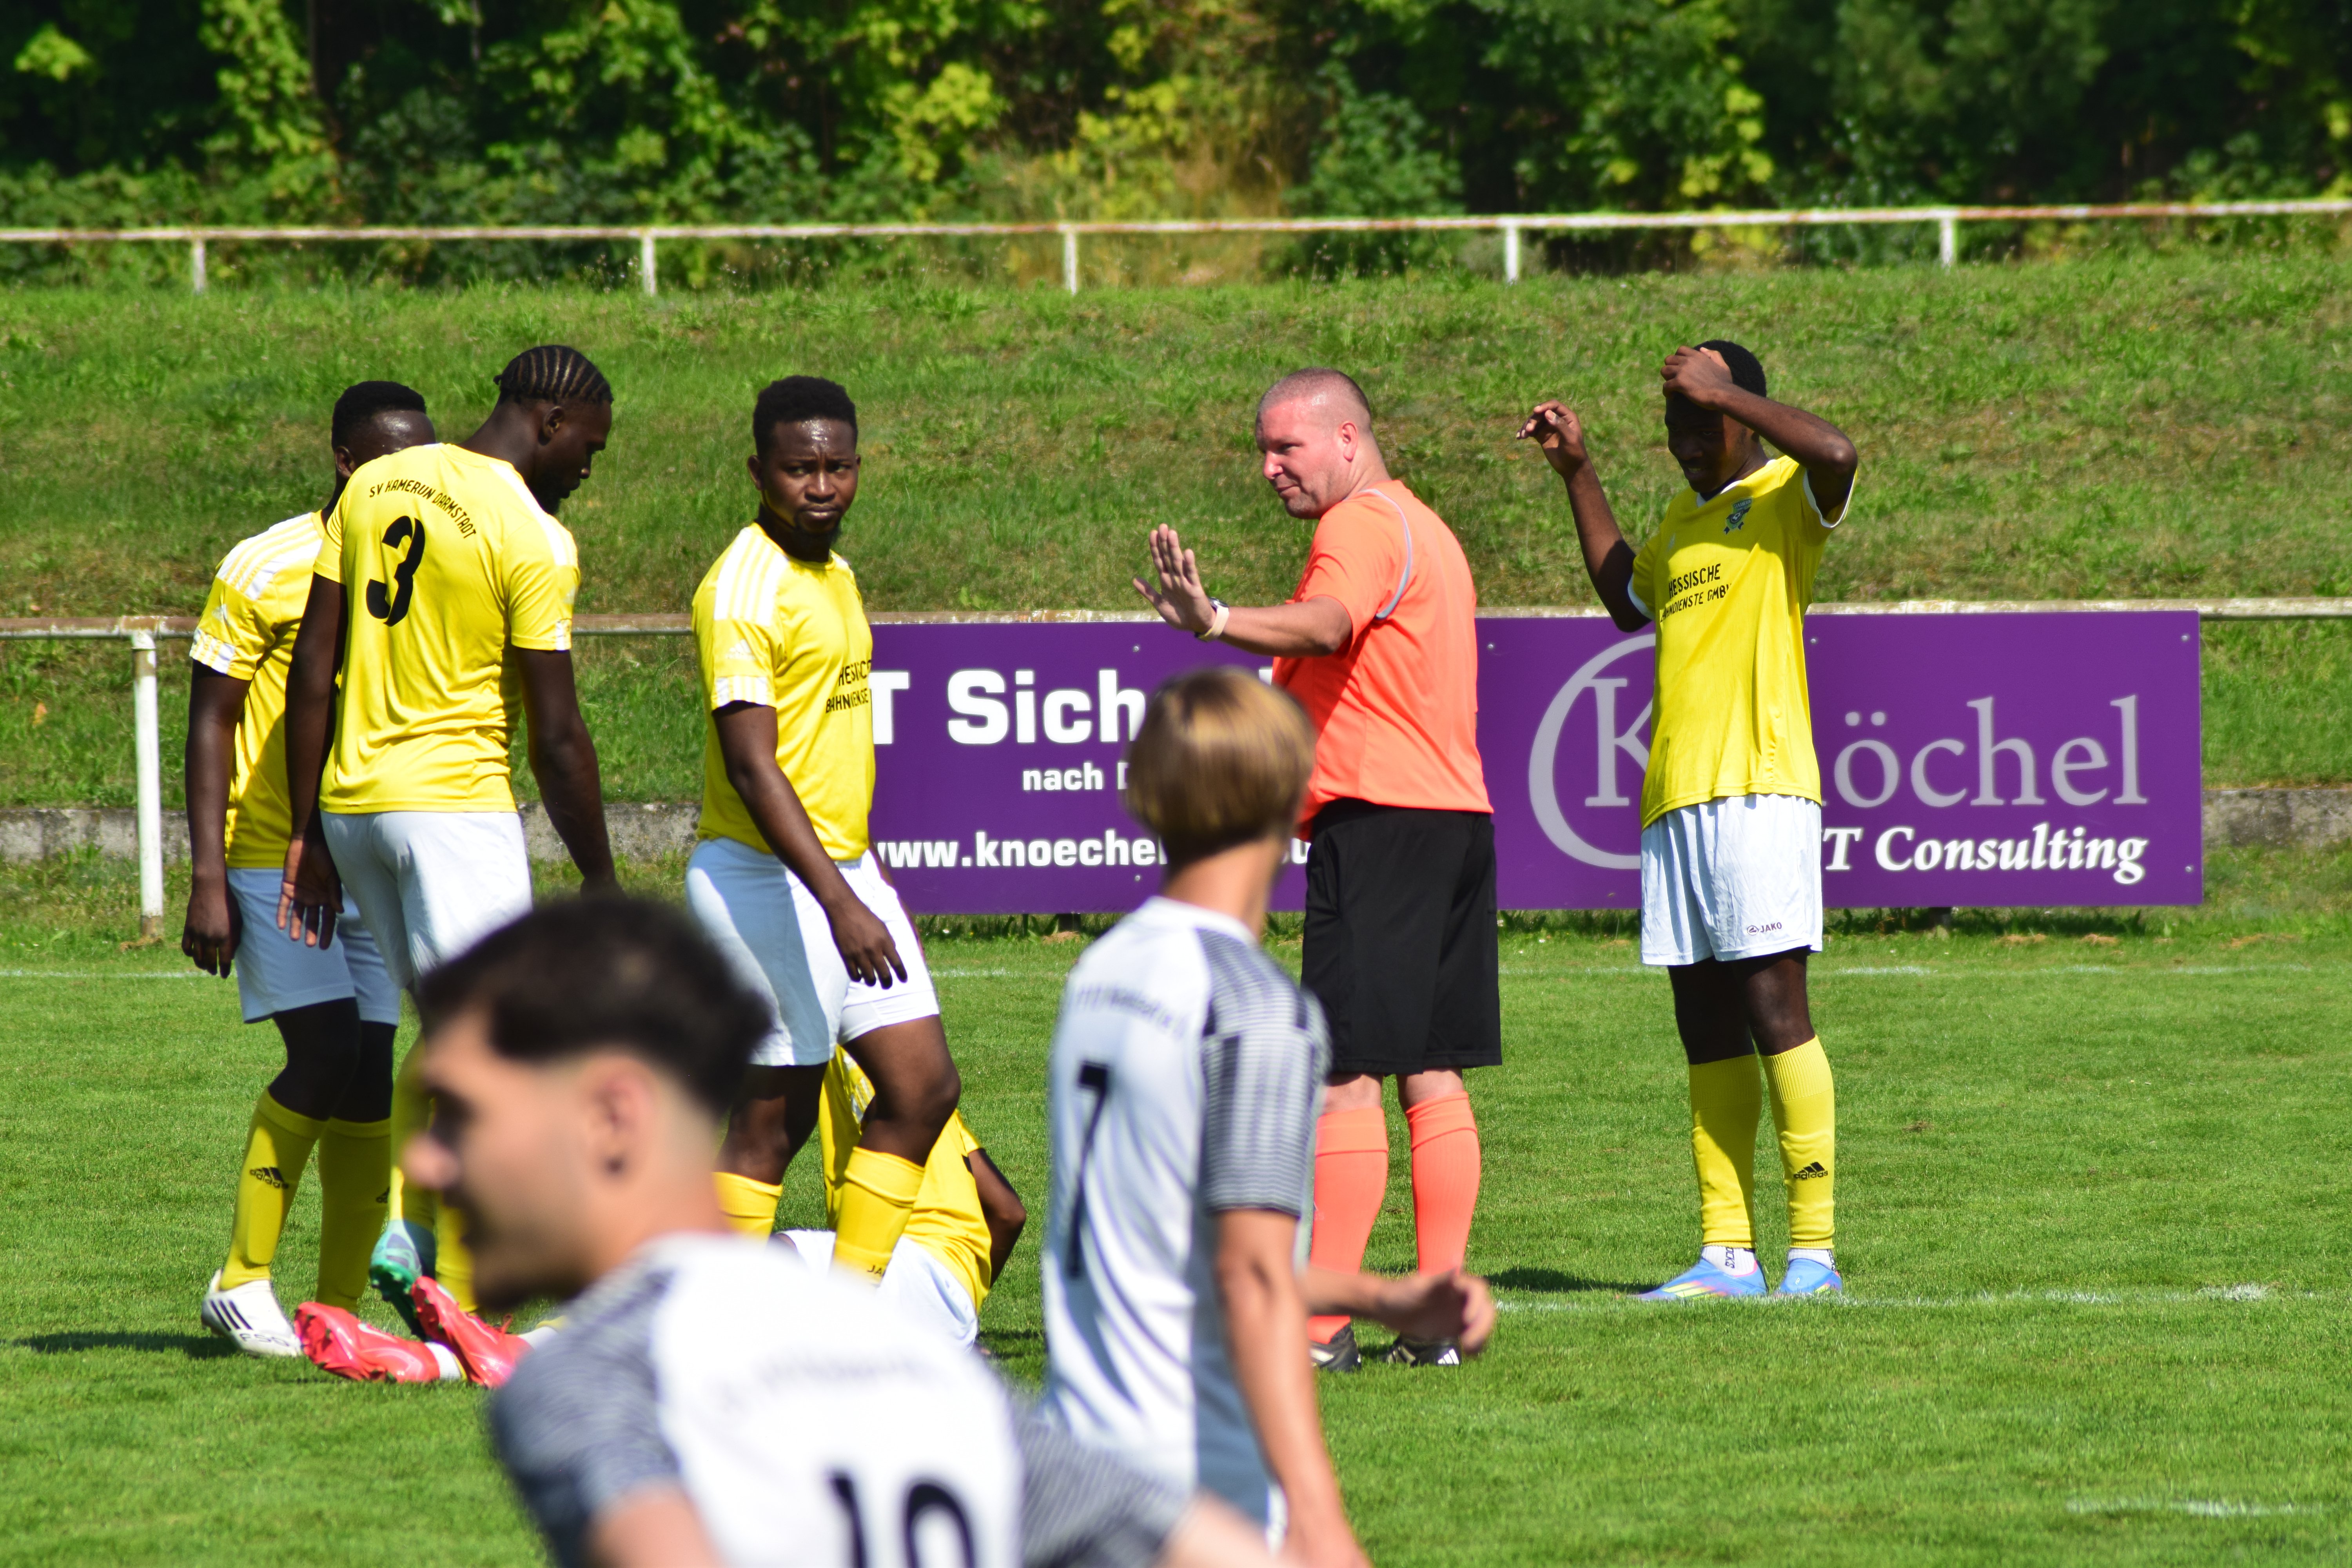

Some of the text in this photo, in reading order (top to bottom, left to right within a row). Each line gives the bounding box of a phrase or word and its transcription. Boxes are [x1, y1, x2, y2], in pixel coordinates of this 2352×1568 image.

[369, 479, 477, 539] SV KAMERUN DARMSTADT
[365, 515, 426, 627] 3
[1668, 563, 1721, 600] HESSISCHE
[948, 669, 1146, 744] Sich
[1023, 761, 1103, 791] nach
[1820, 822, 2149, 884] T Consulting
[1760, 922, 1782, 933] JAKO
[1066, 1061, 1109, 1278] 7
[1793, 1170, 1828, 1180] adidas
[866, 1265, 886, 1277] JA
